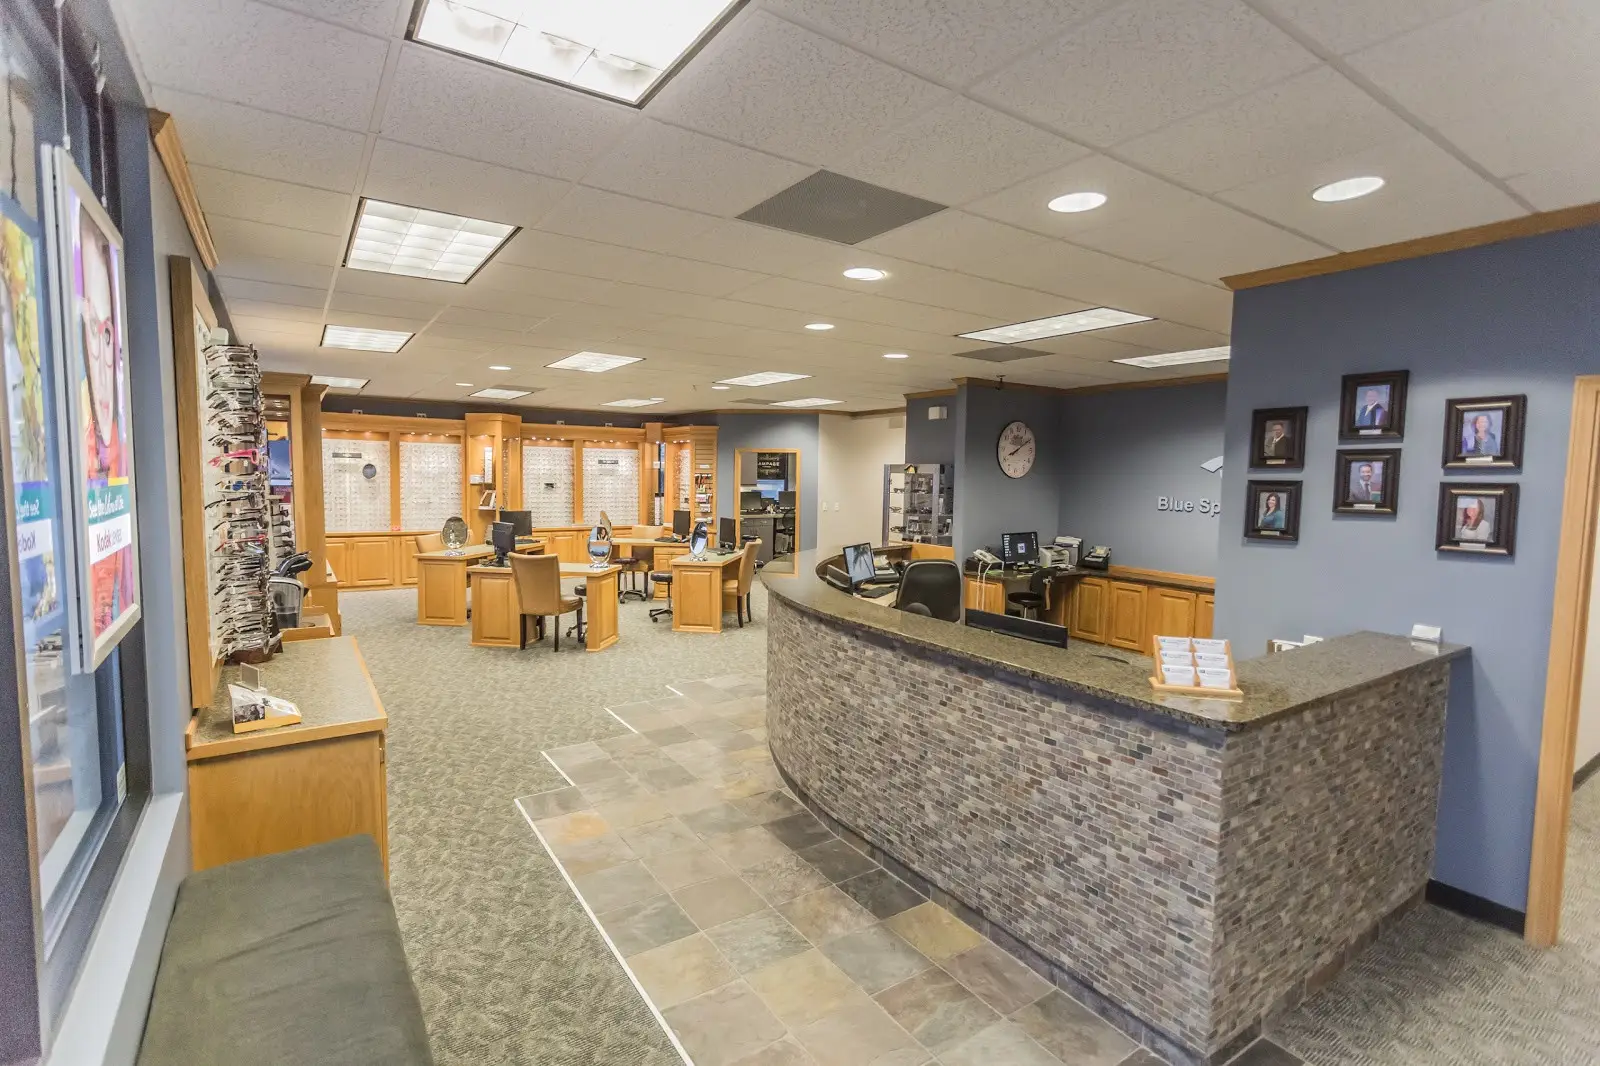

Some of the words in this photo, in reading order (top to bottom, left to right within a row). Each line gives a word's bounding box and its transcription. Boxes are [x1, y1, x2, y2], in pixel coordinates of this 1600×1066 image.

[1158, 496, 1194, 512] Blue
[1199, 498, 1221, 518] Sp
[96, 529, 112, 553] Kodak
